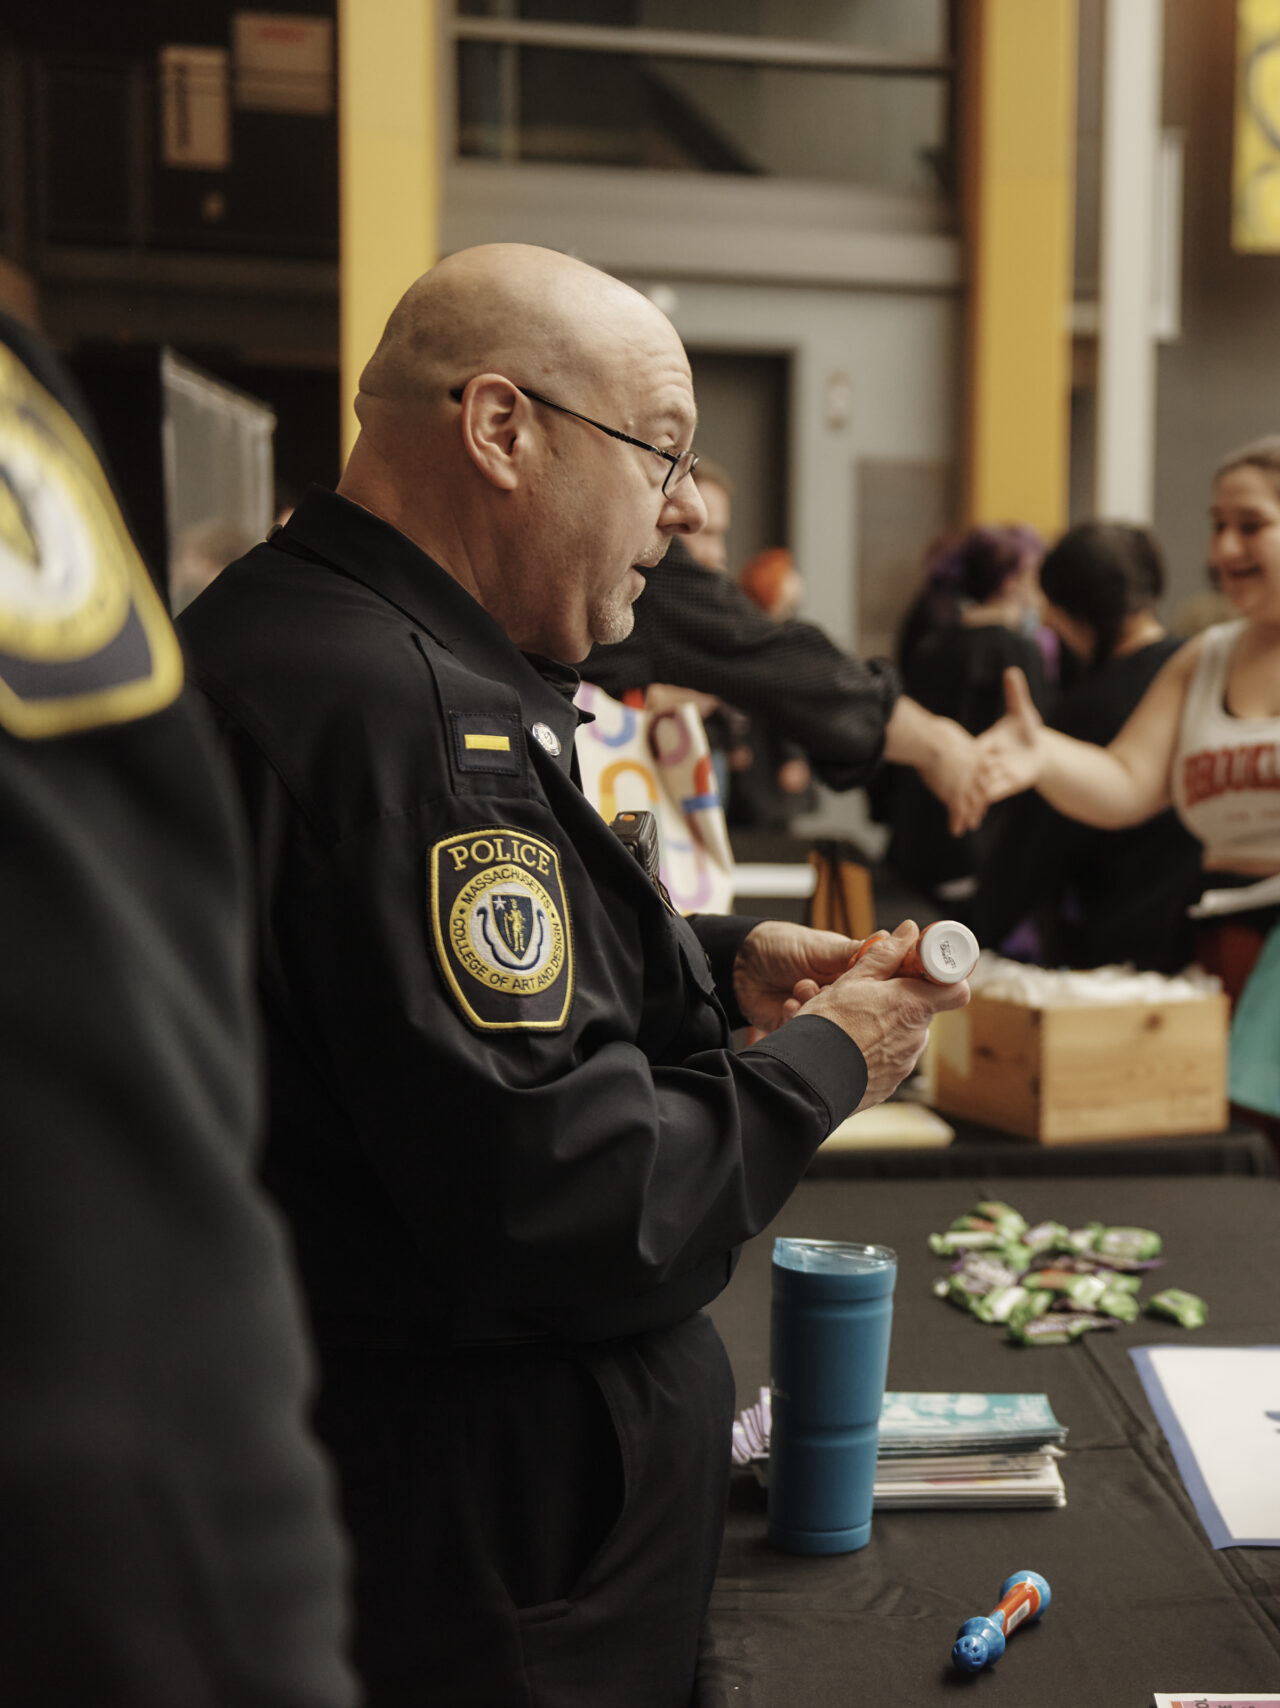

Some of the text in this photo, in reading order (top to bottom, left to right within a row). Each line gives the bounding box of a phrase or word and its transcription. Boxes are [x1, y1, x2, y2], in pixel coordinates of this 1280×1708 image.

[447, 838, 551, 876] POLICE
[460, 867, 550, 909] MASSACHUSETTS
[452, 918, 563, 991] COLLEGE OF ART AND DESIGN
